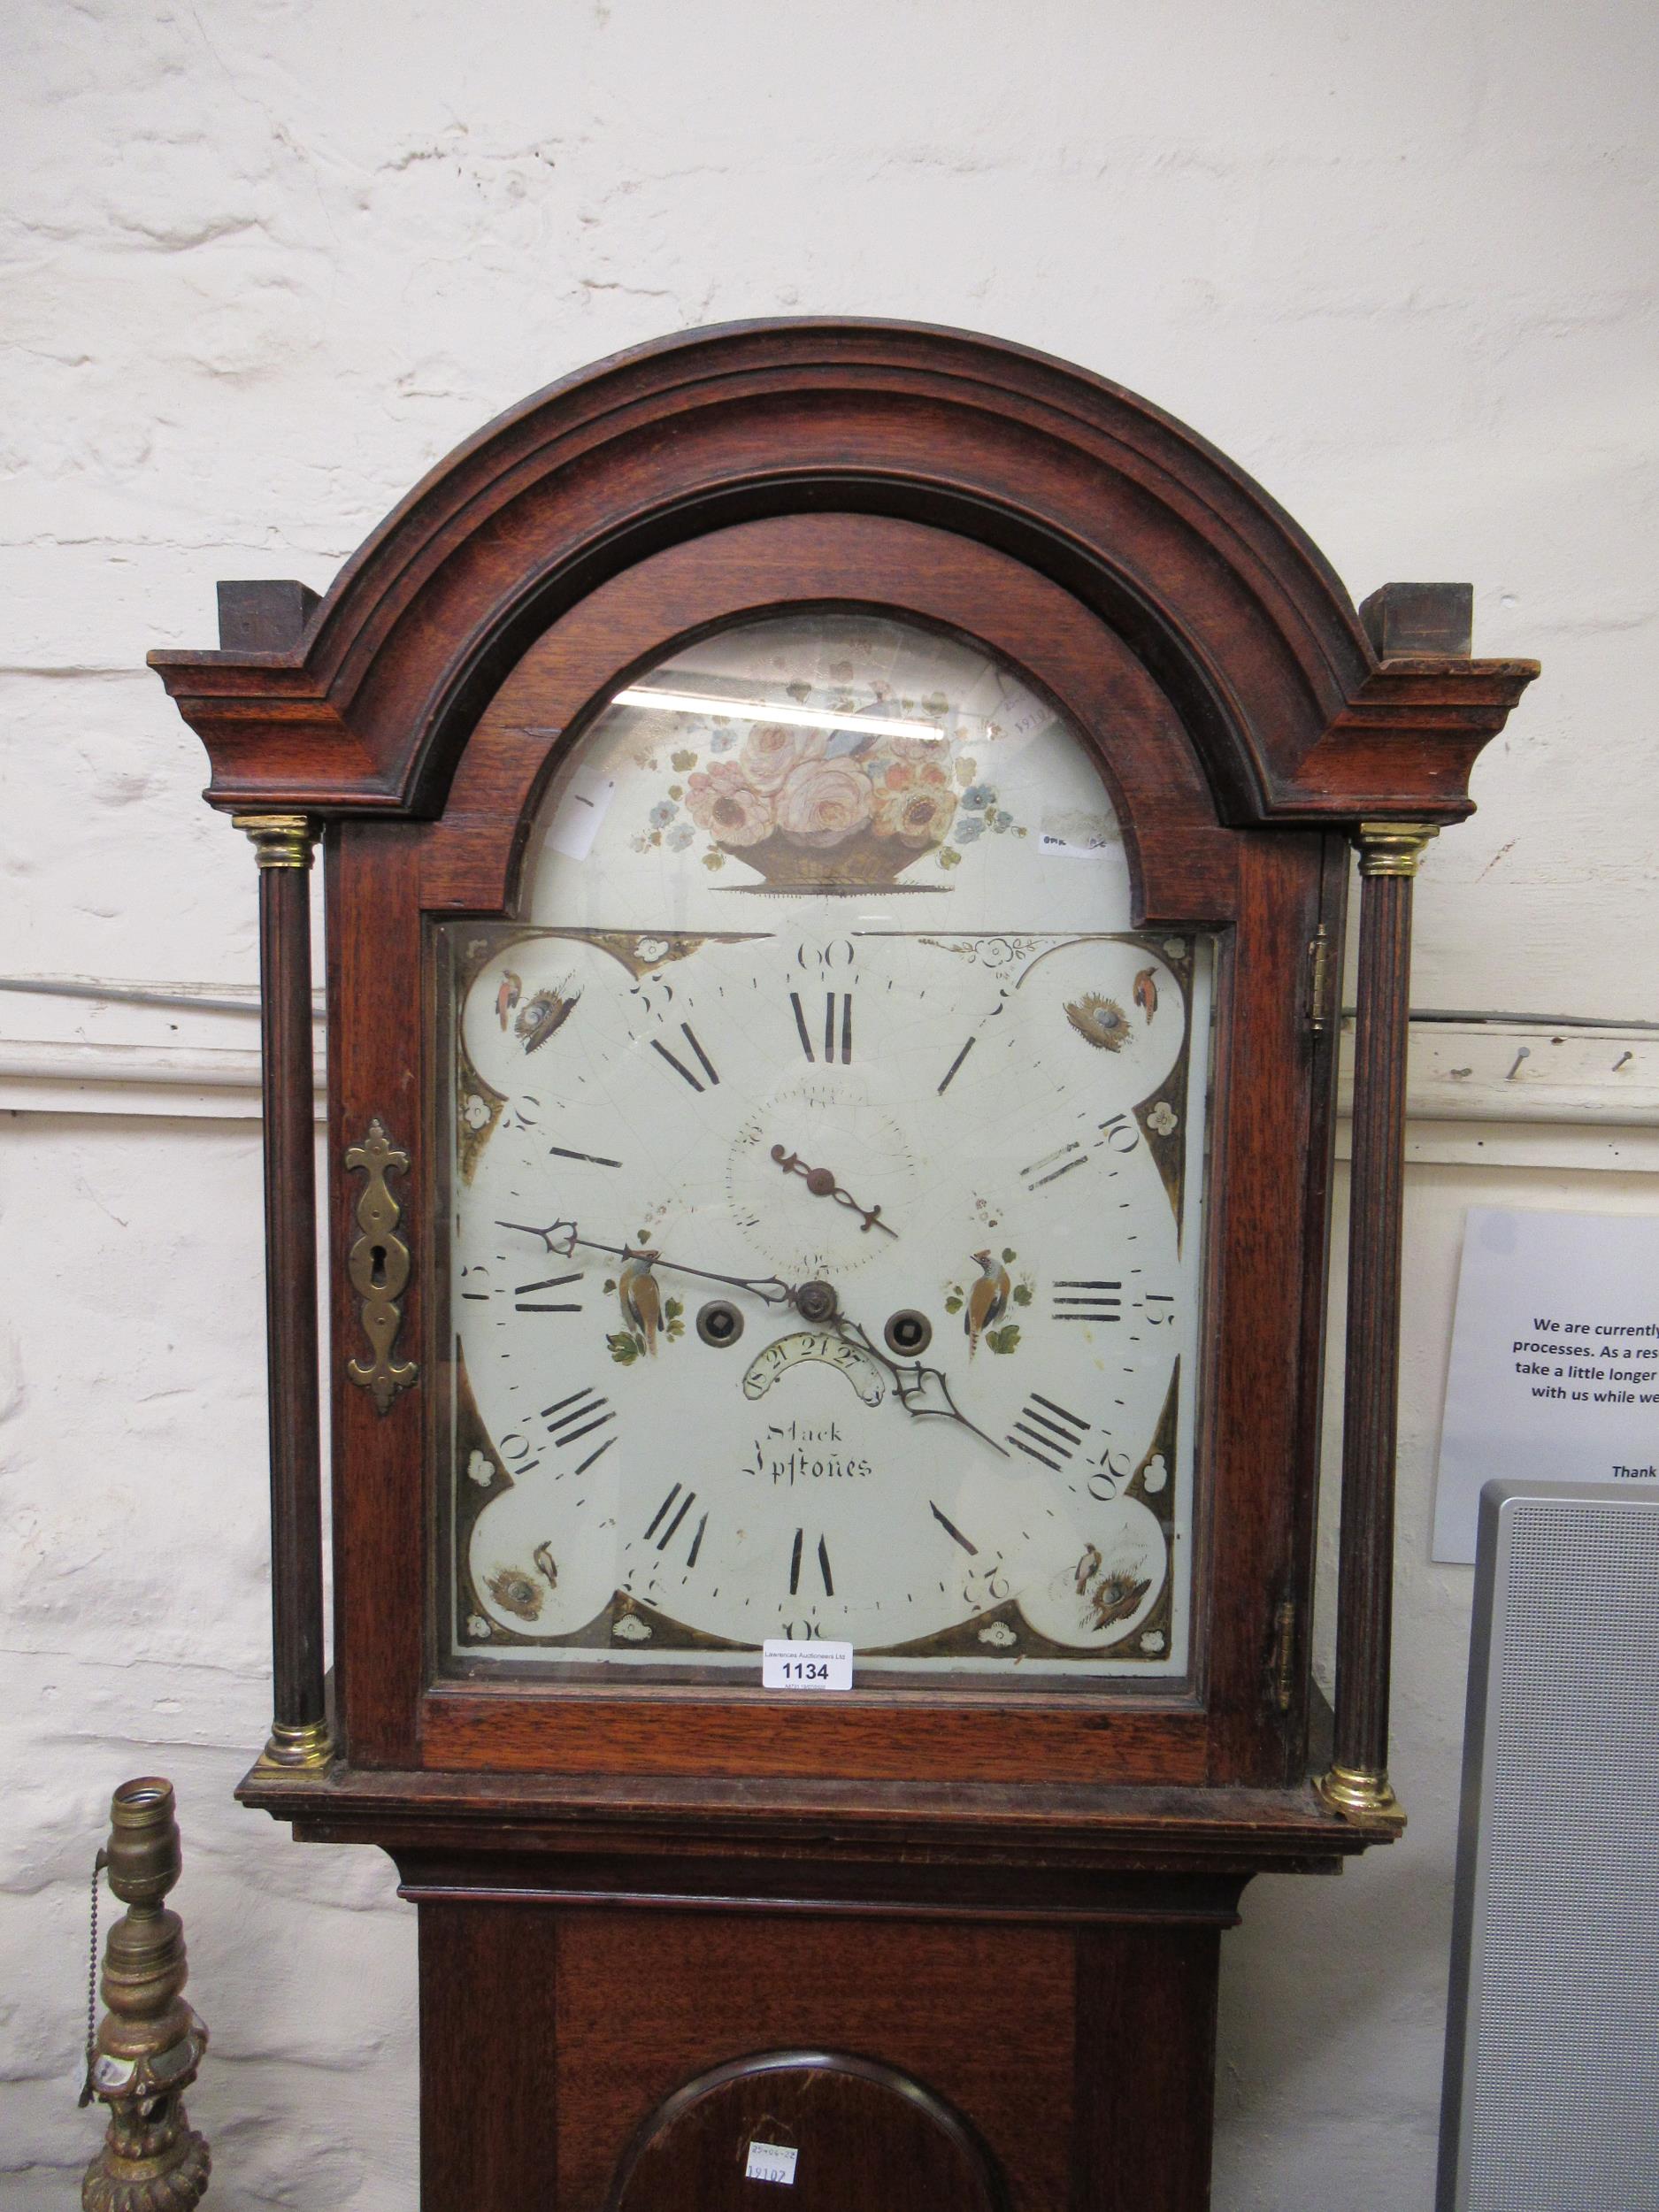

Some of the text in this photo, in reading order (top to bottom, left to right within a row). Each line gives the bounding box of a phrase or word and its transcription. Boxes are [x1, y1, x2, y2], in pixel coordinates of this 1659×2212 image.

[1533, 1317, 1561, 1333] We
[1564, 1322, 1591, 1334] are
[1513, 1340, 1595, 1357] processes.
[1600, 1346, 1618, 1358] As
[1623, 1348, 1632, 1358] a
[1516, 1362, 1657, 1384] take a little longer
[1532, 1386, 1659, 1403] with us while we
[1612, 1465, 1657, 1479] Thank
[782, 1663, 829, 1679] 1134
